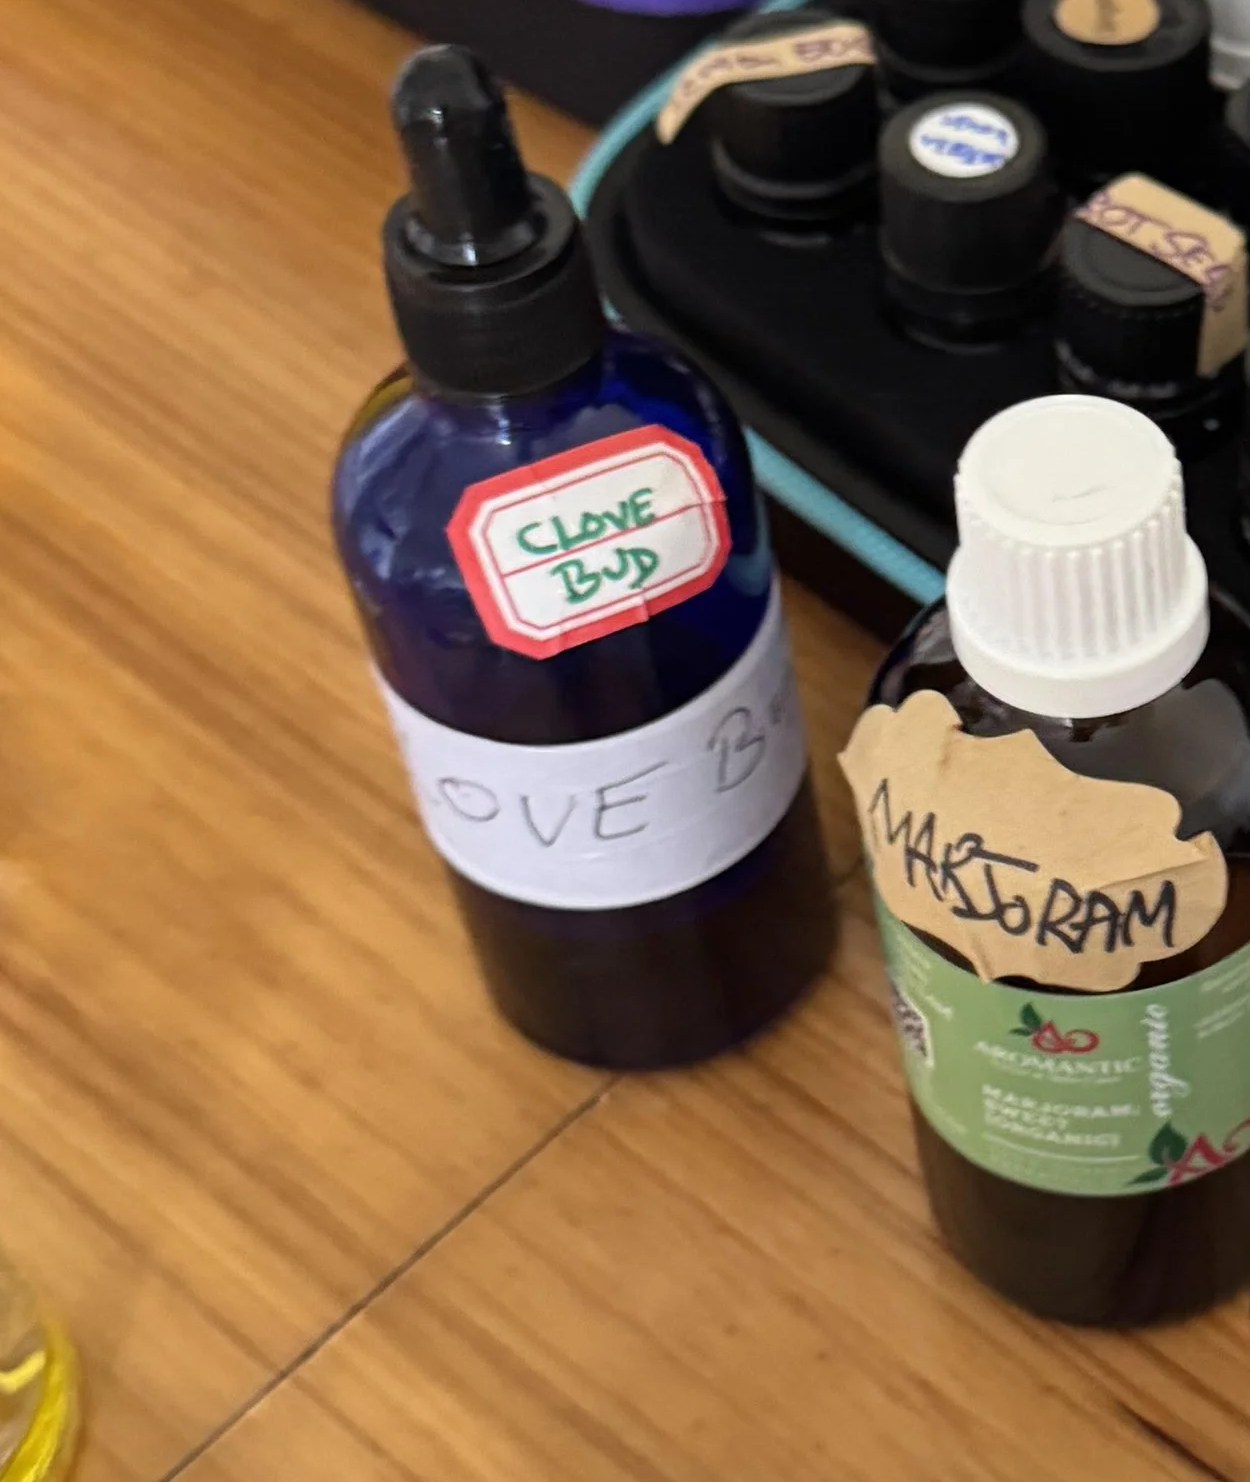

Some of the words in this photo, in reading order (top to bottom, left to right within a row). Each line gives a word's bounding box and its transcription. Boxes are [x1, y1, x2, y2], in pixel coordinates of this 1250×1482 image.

[516, 487, 656, 554] CLOVE
[550, 547, 659, 604] BUD
[437, 759, 671, 848] OVE
[868, 778, 1176, 955] MARJORAM
[973, 1040, 1143, 1076] AROMANTIC
[1141, 1003, 1191, 1118] organic
